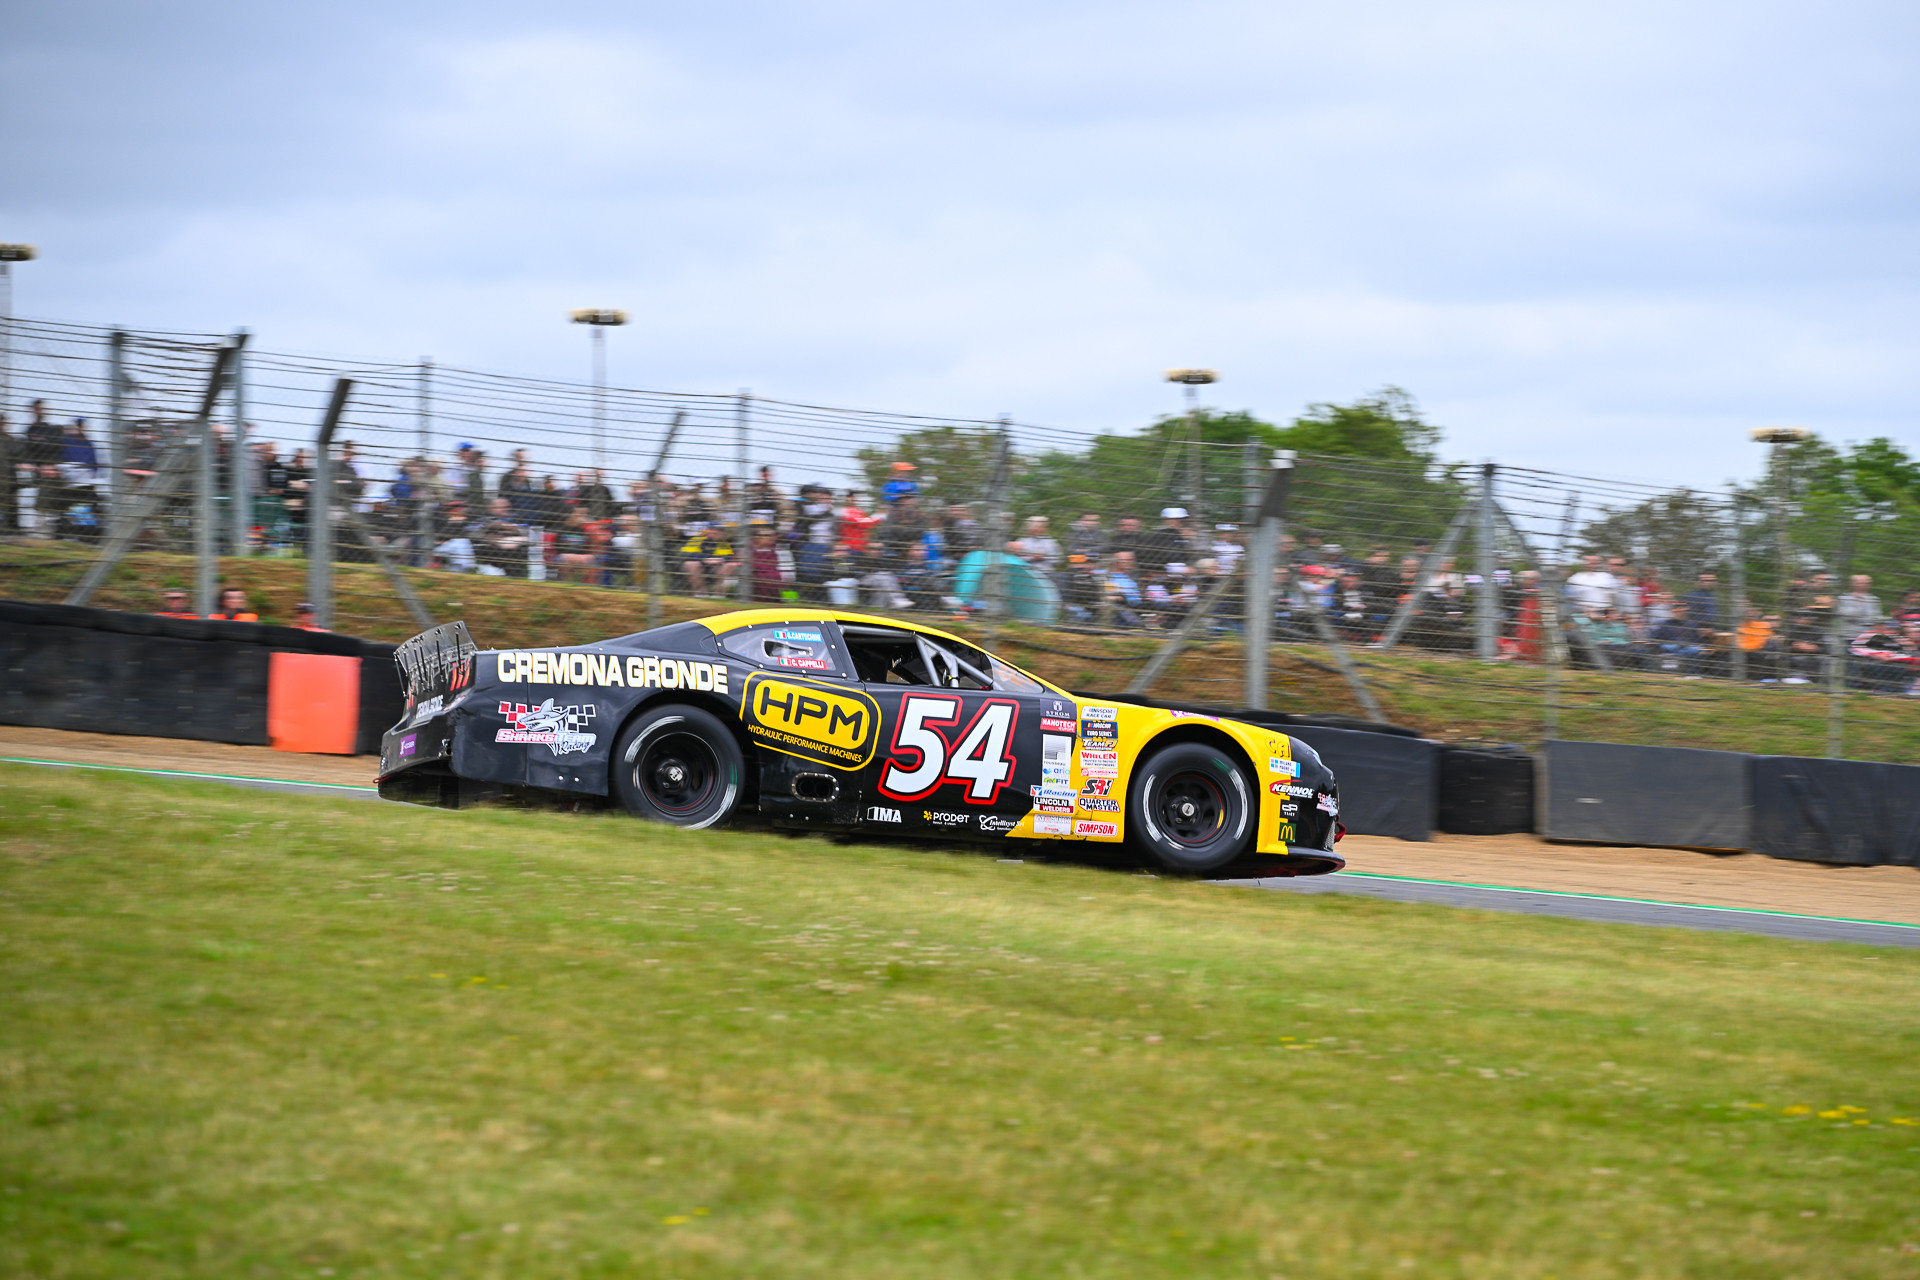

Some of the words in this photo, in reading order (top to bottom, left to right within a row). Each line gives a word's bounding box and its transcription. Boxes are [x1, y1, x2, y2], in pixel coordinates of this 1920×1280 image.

[798, 659, 825, 669] CAPPELLI
[497, 652, 626, 688] CREMONA
[626, 656, 729, 695] GRONDE
[759, 686, 864, 742] HPM
[1042, 718, 1076, 728] NANOTECH
[497, 730, 555, 743] SHARKS
[555, 733, 596, 745] TEAM
[747, 724, 783, 742] HYDRAULIC
[783, 734, 829, 754] PERFORMANCE
[829, 747, 863, 763] MACHINES
[559, 740, 591, 755] Racing
[882, 695, 1017, 802] 54
[1081, 751, 1117, 760] WHELEN
[1053, 767, 1071, 775] aria
[1043, 789, 1076, 797] iRacing
[1081, 778, 1112, 796] SRI
[1271, 783, 1313, 796] KENNOL
[1035, 797, 1068, 807] LINCOLN
[1079, 798, 1117, 806] QUARTER
[1085, 804, 1119, 812] MASTER
[873, 806, 902, 823] IMA
[1042, 806, 1071, 814] WELDERS
[1077, 823, 1115, 835] SIMPSON
